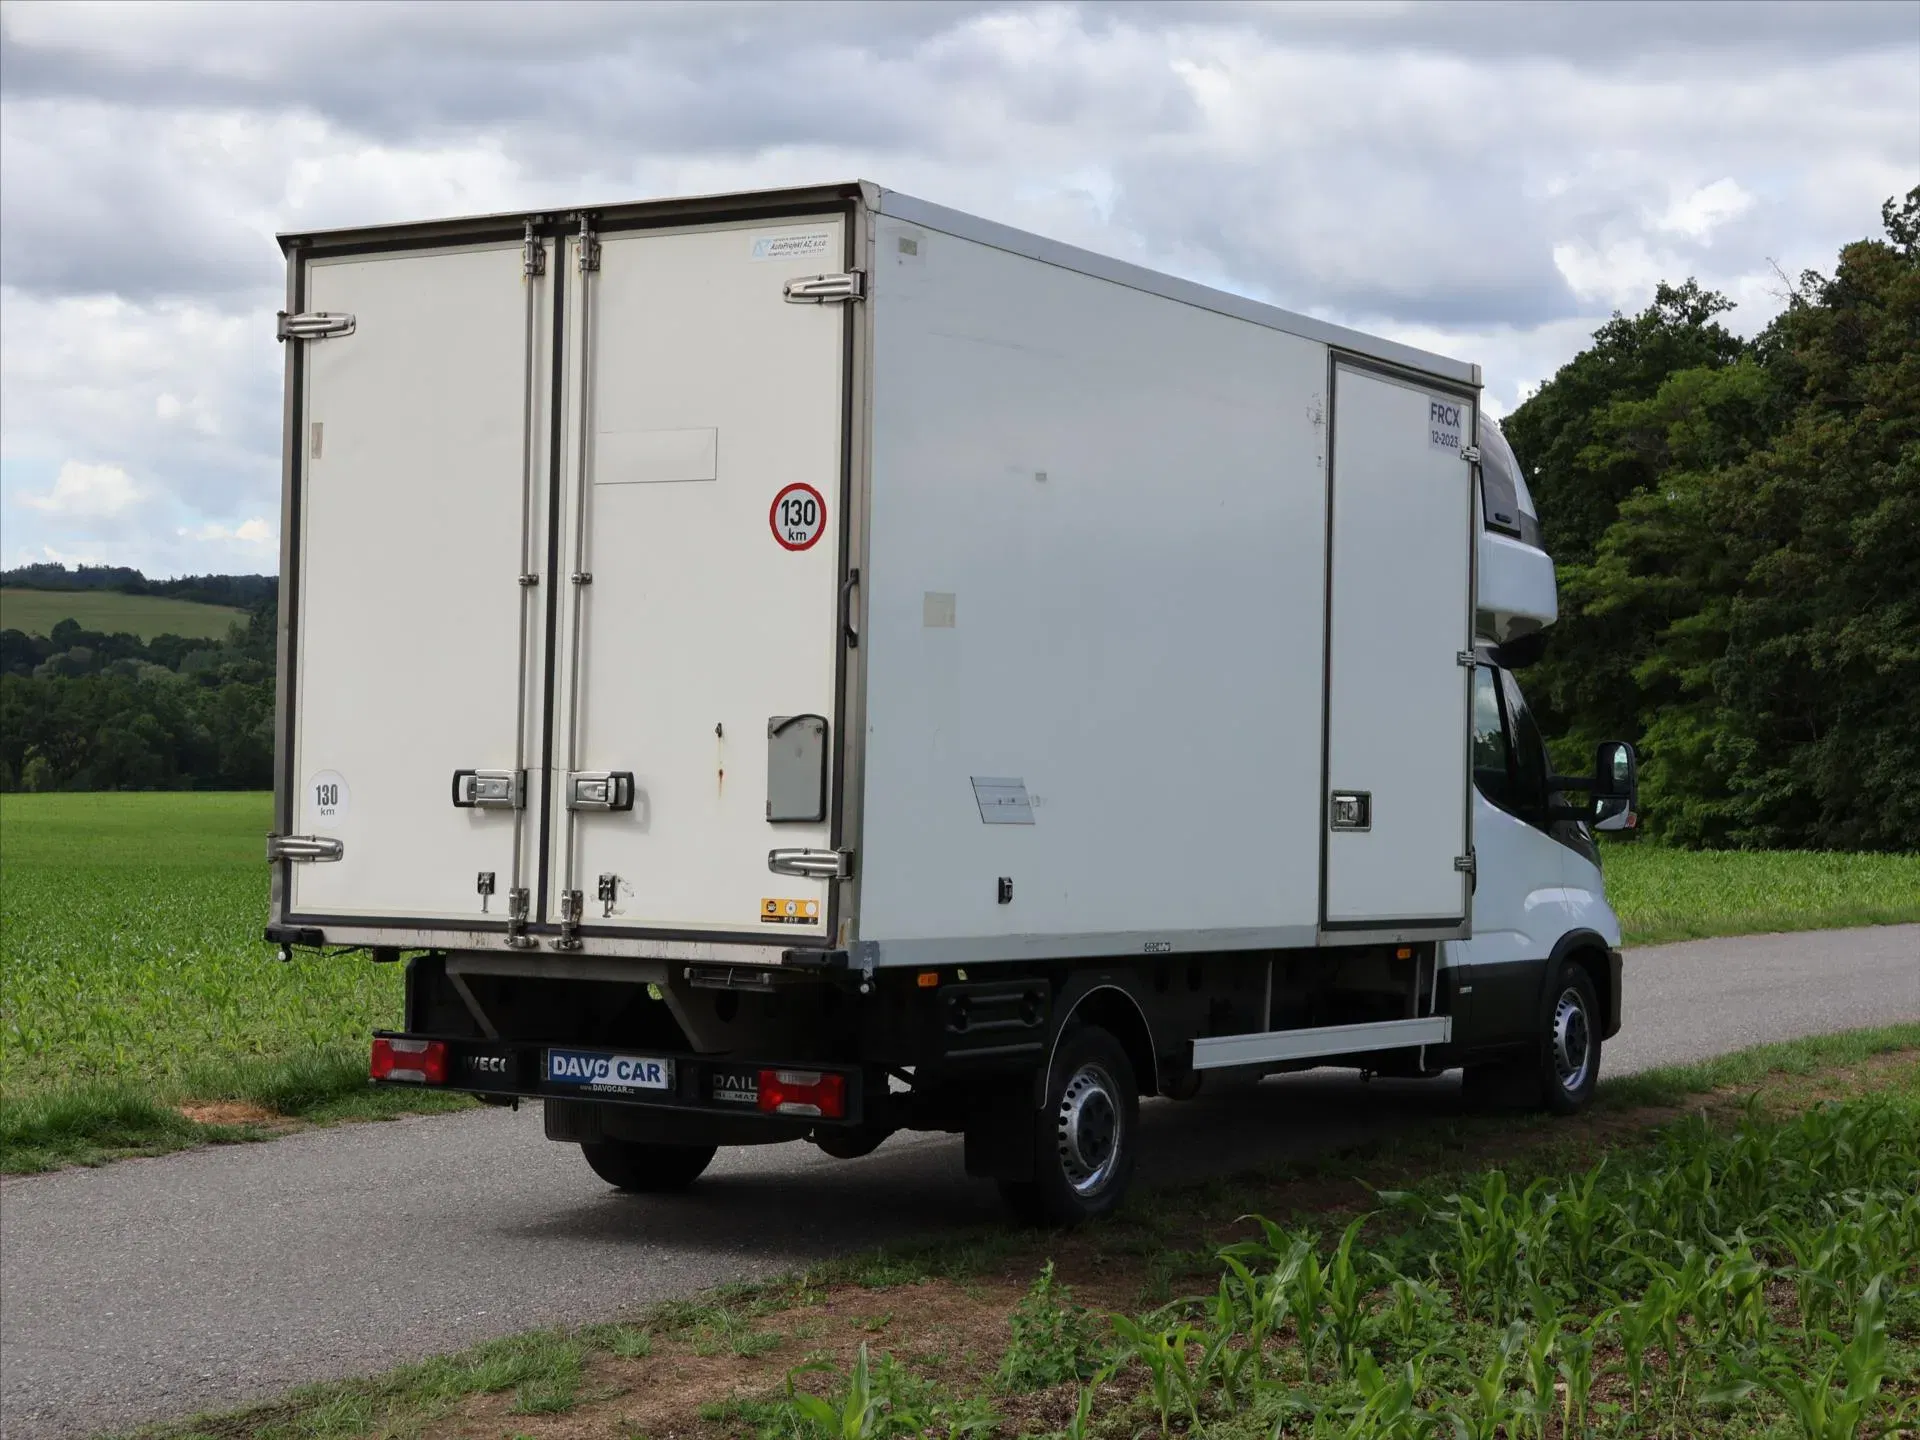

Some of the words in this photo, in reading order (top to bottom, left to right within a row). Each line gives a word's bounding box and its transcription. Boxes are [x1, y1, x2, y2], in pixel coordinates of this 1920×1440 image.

[1431, 402, 1460, 428] FRCX
[1431, 430, 1459, 448] 12-2023
[781, 499, 816, 526] 130
[788, 528, 807, 541] km
[316, 784, 338, 806] 130
[320, 808, 335, 816] km
[552, 1056, 610, 1079] DAVO
[616, 1061, 661, 1082] CAR
[713, 1074, 758, 1090] DAIL
